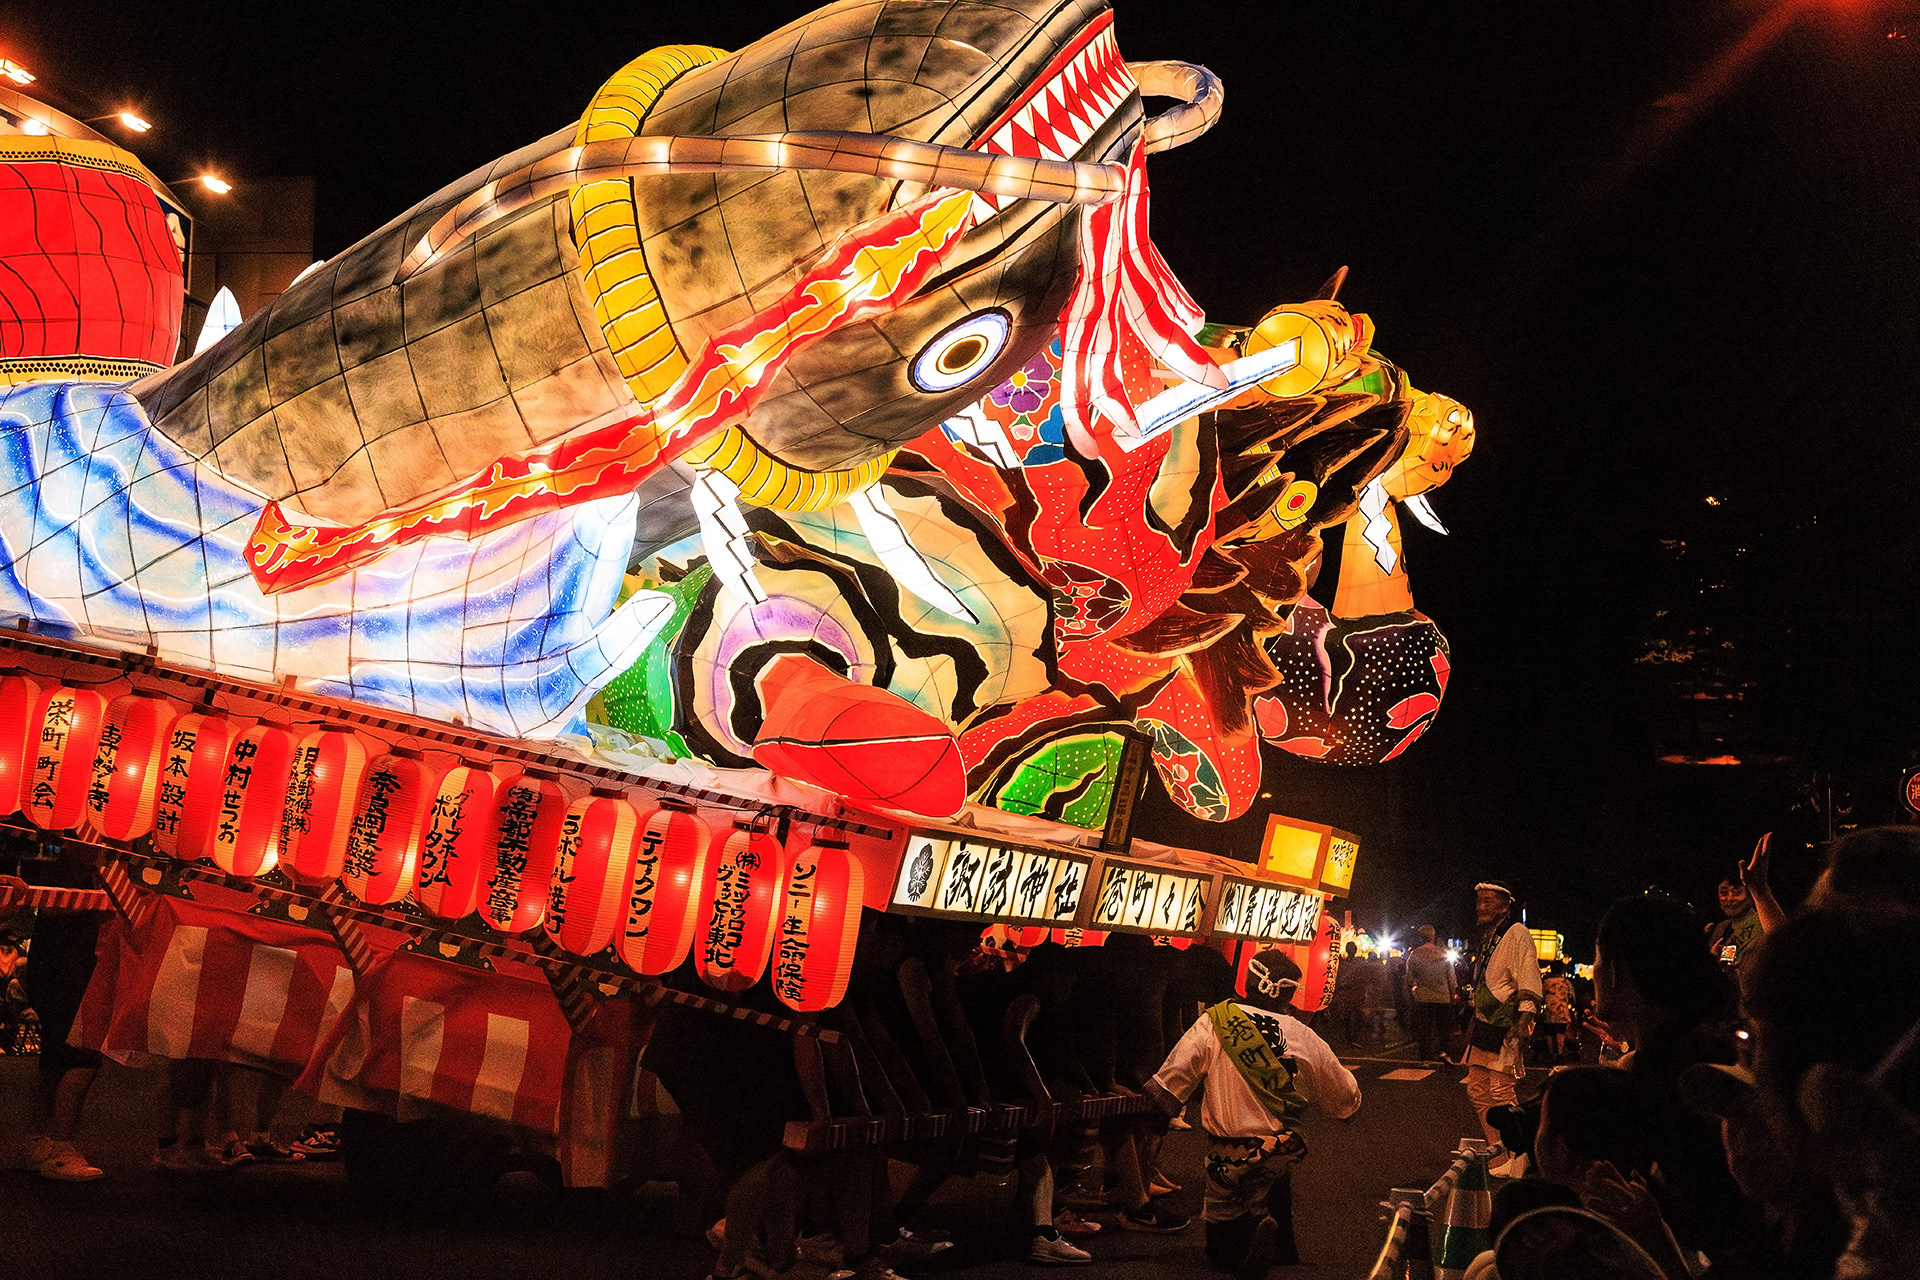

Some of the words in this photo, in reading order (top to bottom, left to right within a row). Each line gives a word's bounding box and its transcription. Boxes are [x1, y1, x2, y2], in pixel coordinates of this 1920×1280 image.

[156, 730, 197, 836] 坂本設計
[217, 739, 258, 844] 中村せつお
[418, 795, 453, 889] ポータウン
[433, 789, 475, 888] グループホーム
[703, 864, 737, 969] ヴェッセル東北
[726, 851, 762, 949] (株)ミツウロコ
[775, 863, 817, 1003] ソニー生命保険
